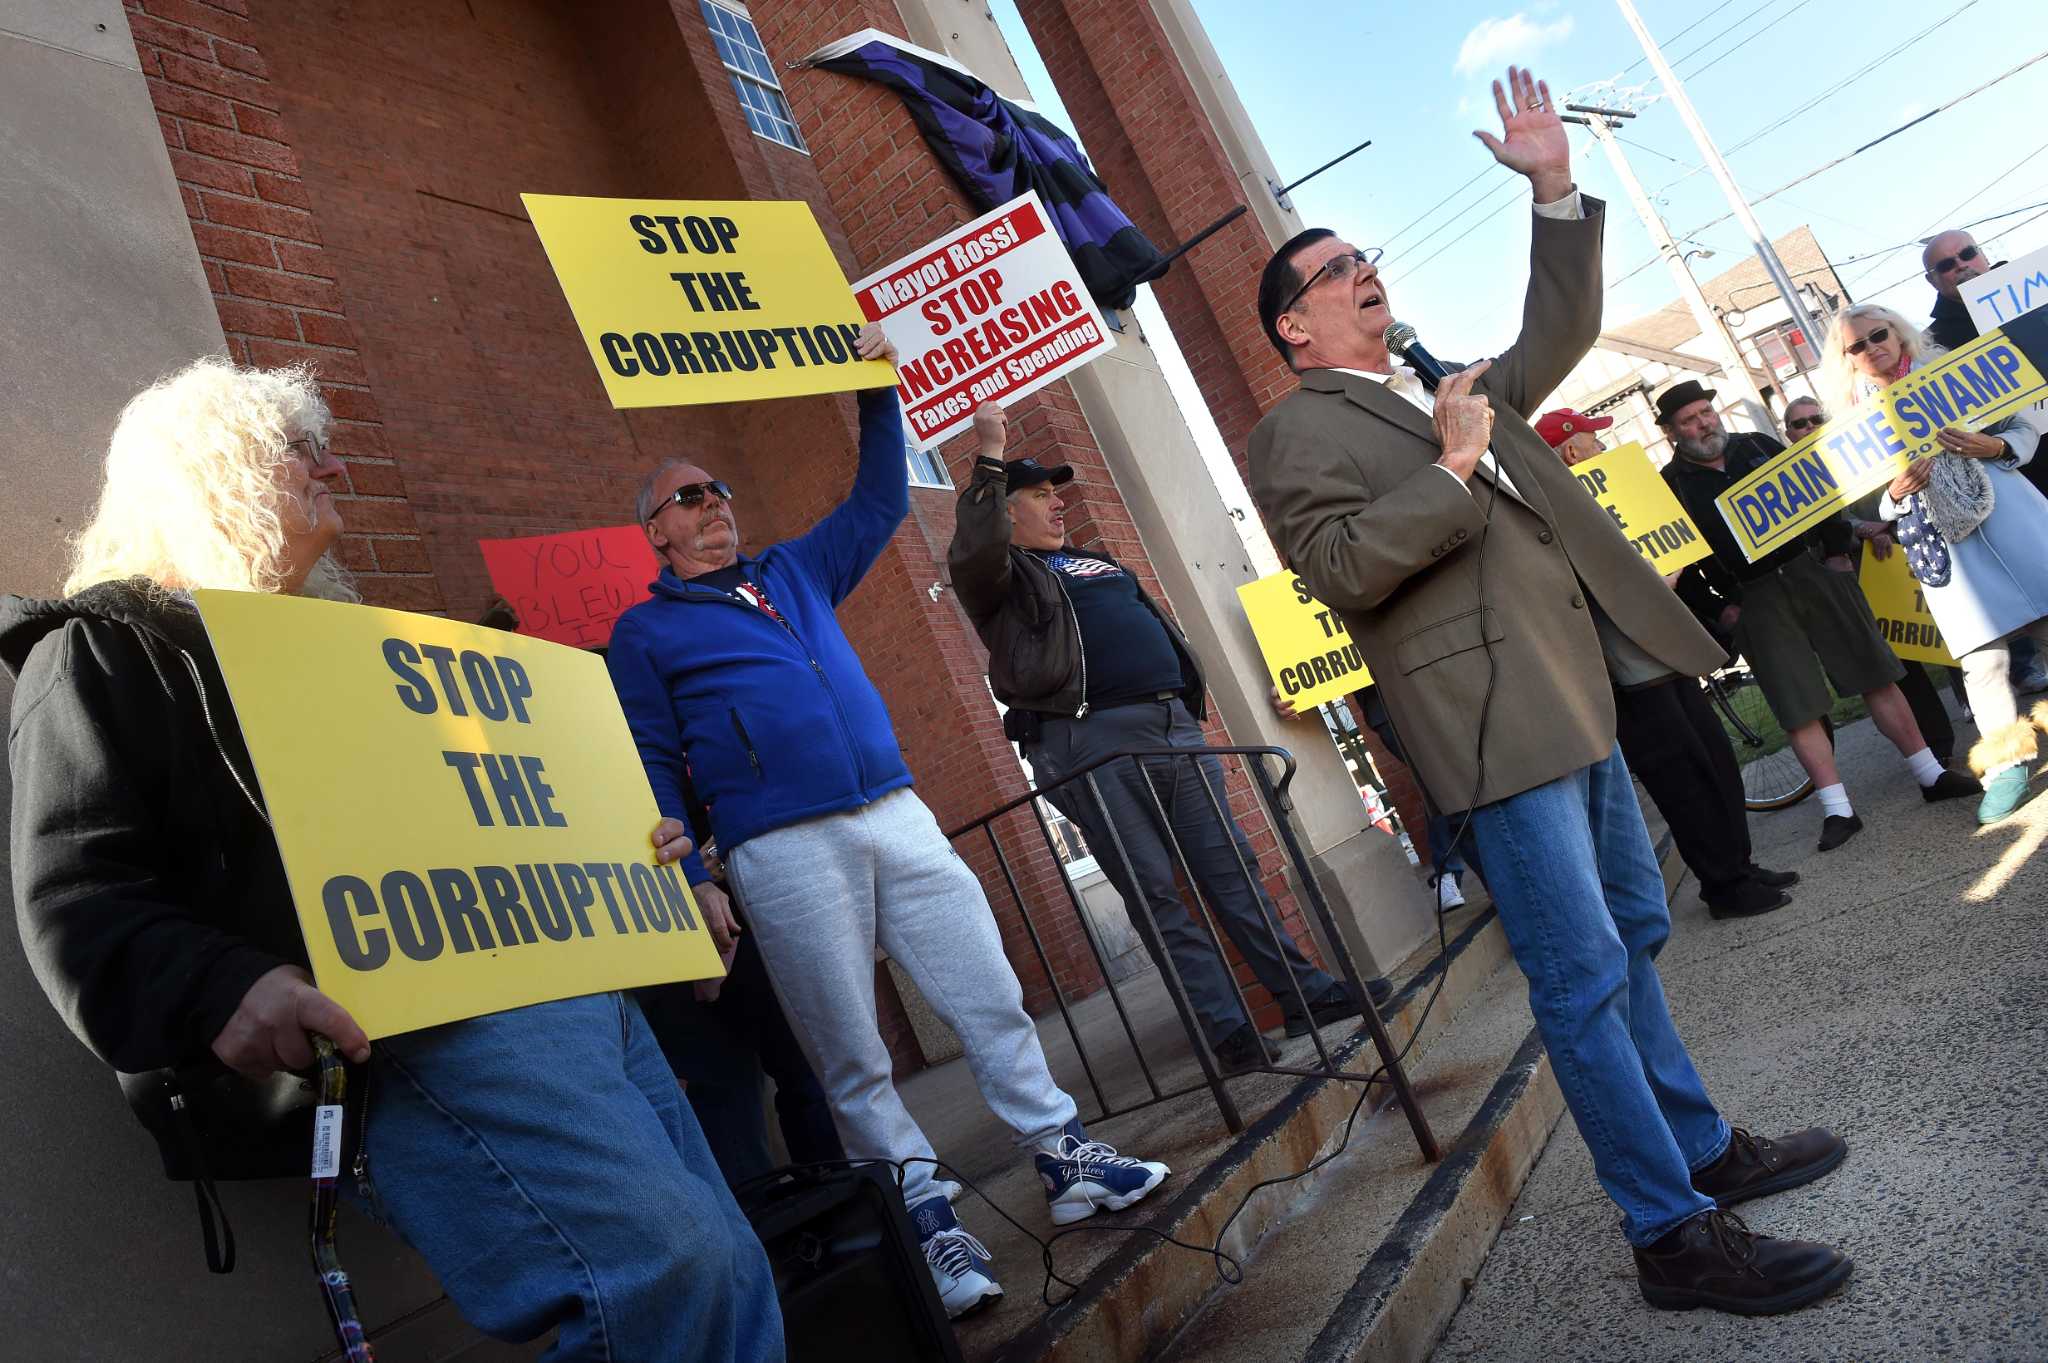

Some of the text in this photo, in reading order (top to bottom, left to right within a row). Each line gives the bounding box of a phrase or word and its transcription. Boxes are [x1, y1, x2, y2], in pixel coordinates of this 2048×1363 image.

[629, 214, 739, 254] STOP
[870, 217, 1021, 313] Mayor Rossi
[670, 271, 761, 313] THE
[921, 267, 1004, 336] STOP
[910, 320, 1099, 433] Taxes and Spending
[1736, 345, 2021, 538] DRAIN THE SWAMP
[520, 537, 630, 589] YOU
[517, 576, 635, 631] BLEW
[381, 637, 533, 724] STOP
[441, 750, 569, 828] THE
[321, 861, 699, 972] CORRUPTION
[1059, 1163, 1106, 1182] Yankees
